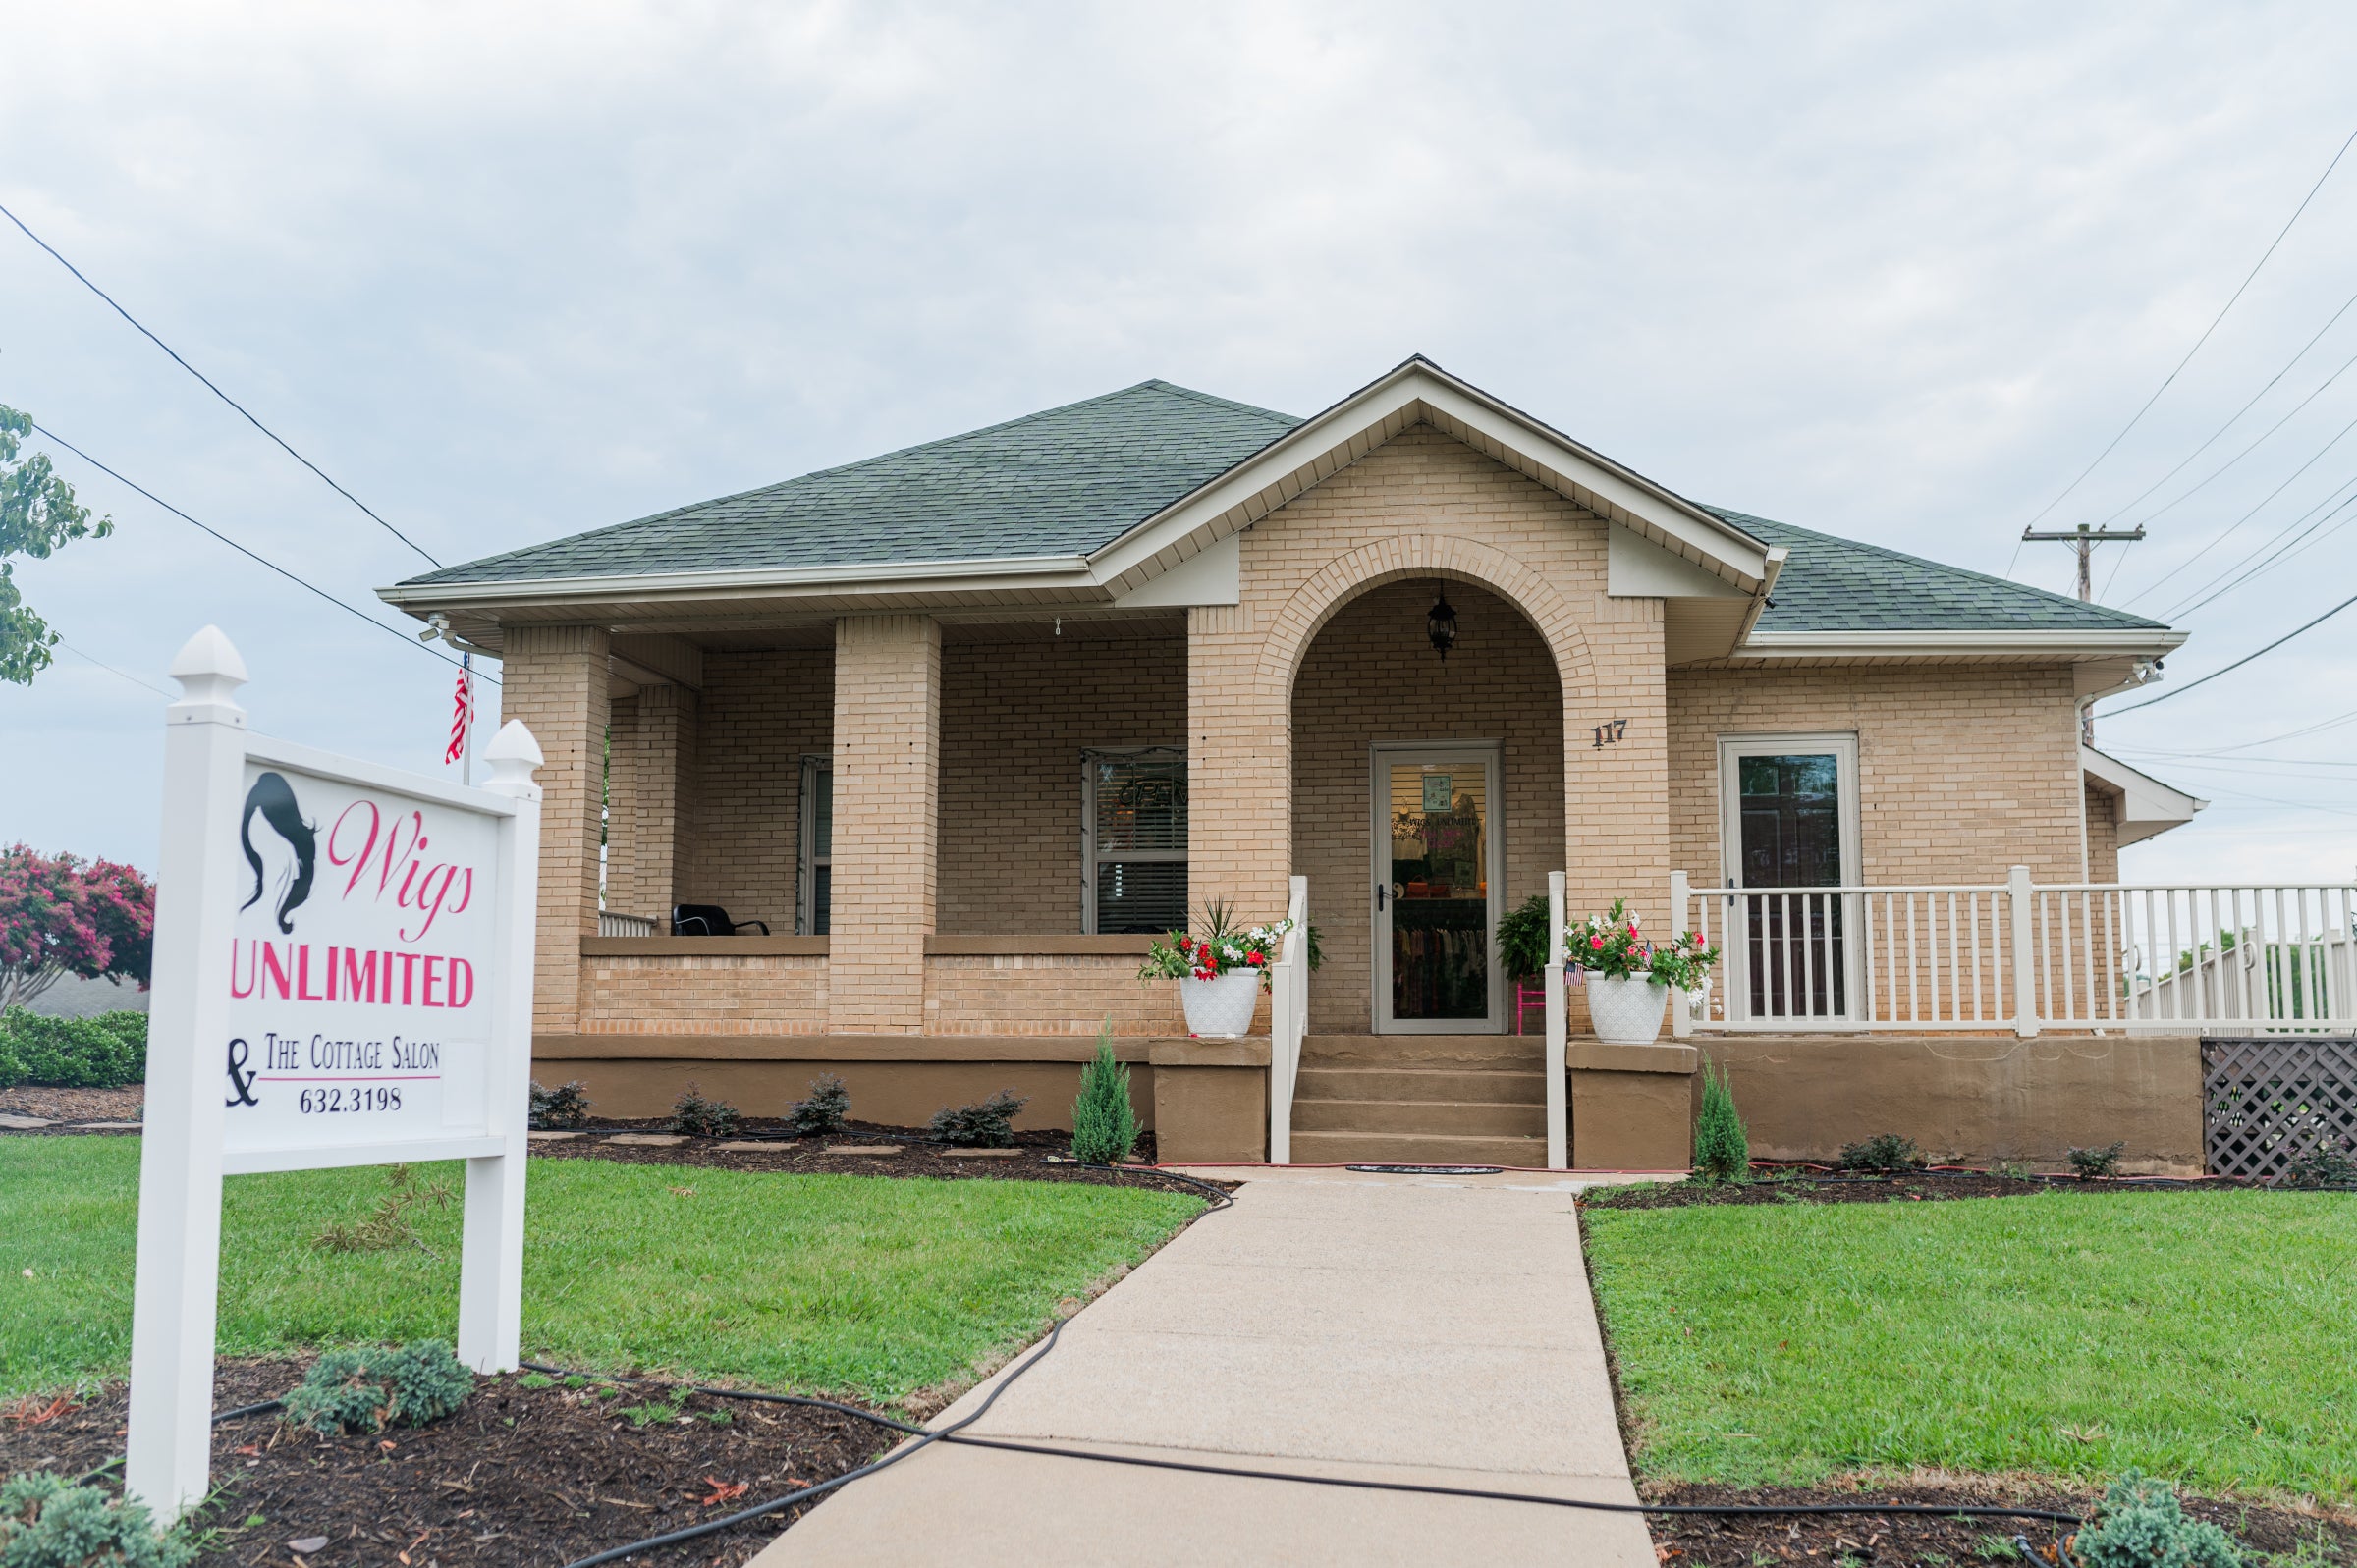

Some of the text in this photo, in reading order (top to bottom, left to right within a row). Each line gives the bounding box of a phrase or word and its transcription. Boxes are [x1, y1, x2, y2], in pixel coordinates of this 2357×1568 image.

[1590, 720, 1627, 747] 117
[1120, 782, 1189, 805] OPEN
[328, 800, 473, 943] Wigs
[231, 938, 474, 1008] UNLIMITED
[265, 1033, 440, 1070] THE COTTAGE SALON
[226, 1038, 259, 1107] &
[300, 1087, 403, 1114] 632.3198
